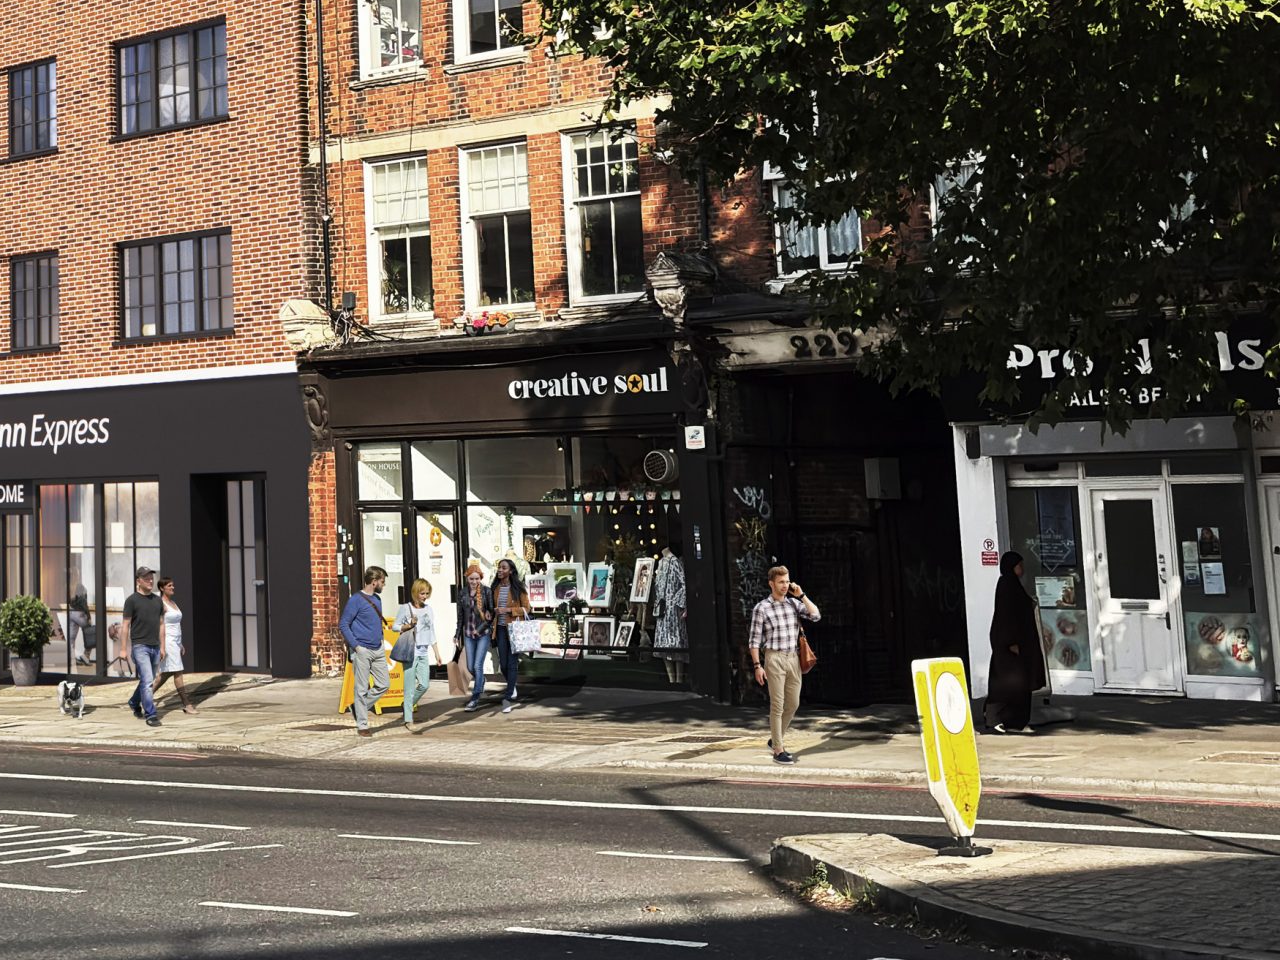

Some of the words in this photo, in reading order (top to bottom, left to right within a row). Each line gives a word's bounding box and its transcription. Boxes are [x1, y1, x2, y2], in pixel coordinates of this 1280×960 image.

[790, 331, 858, 358] 229
[1006, 344, 1094, 380] Pro
[1122, 331, 1265, 375] Nls
[508, 371, 608, 399] creative
[613, 366, 669, 394] soul
[1054, 388, 1110, 407] AILS
[31, 413, 110, 454] Express
